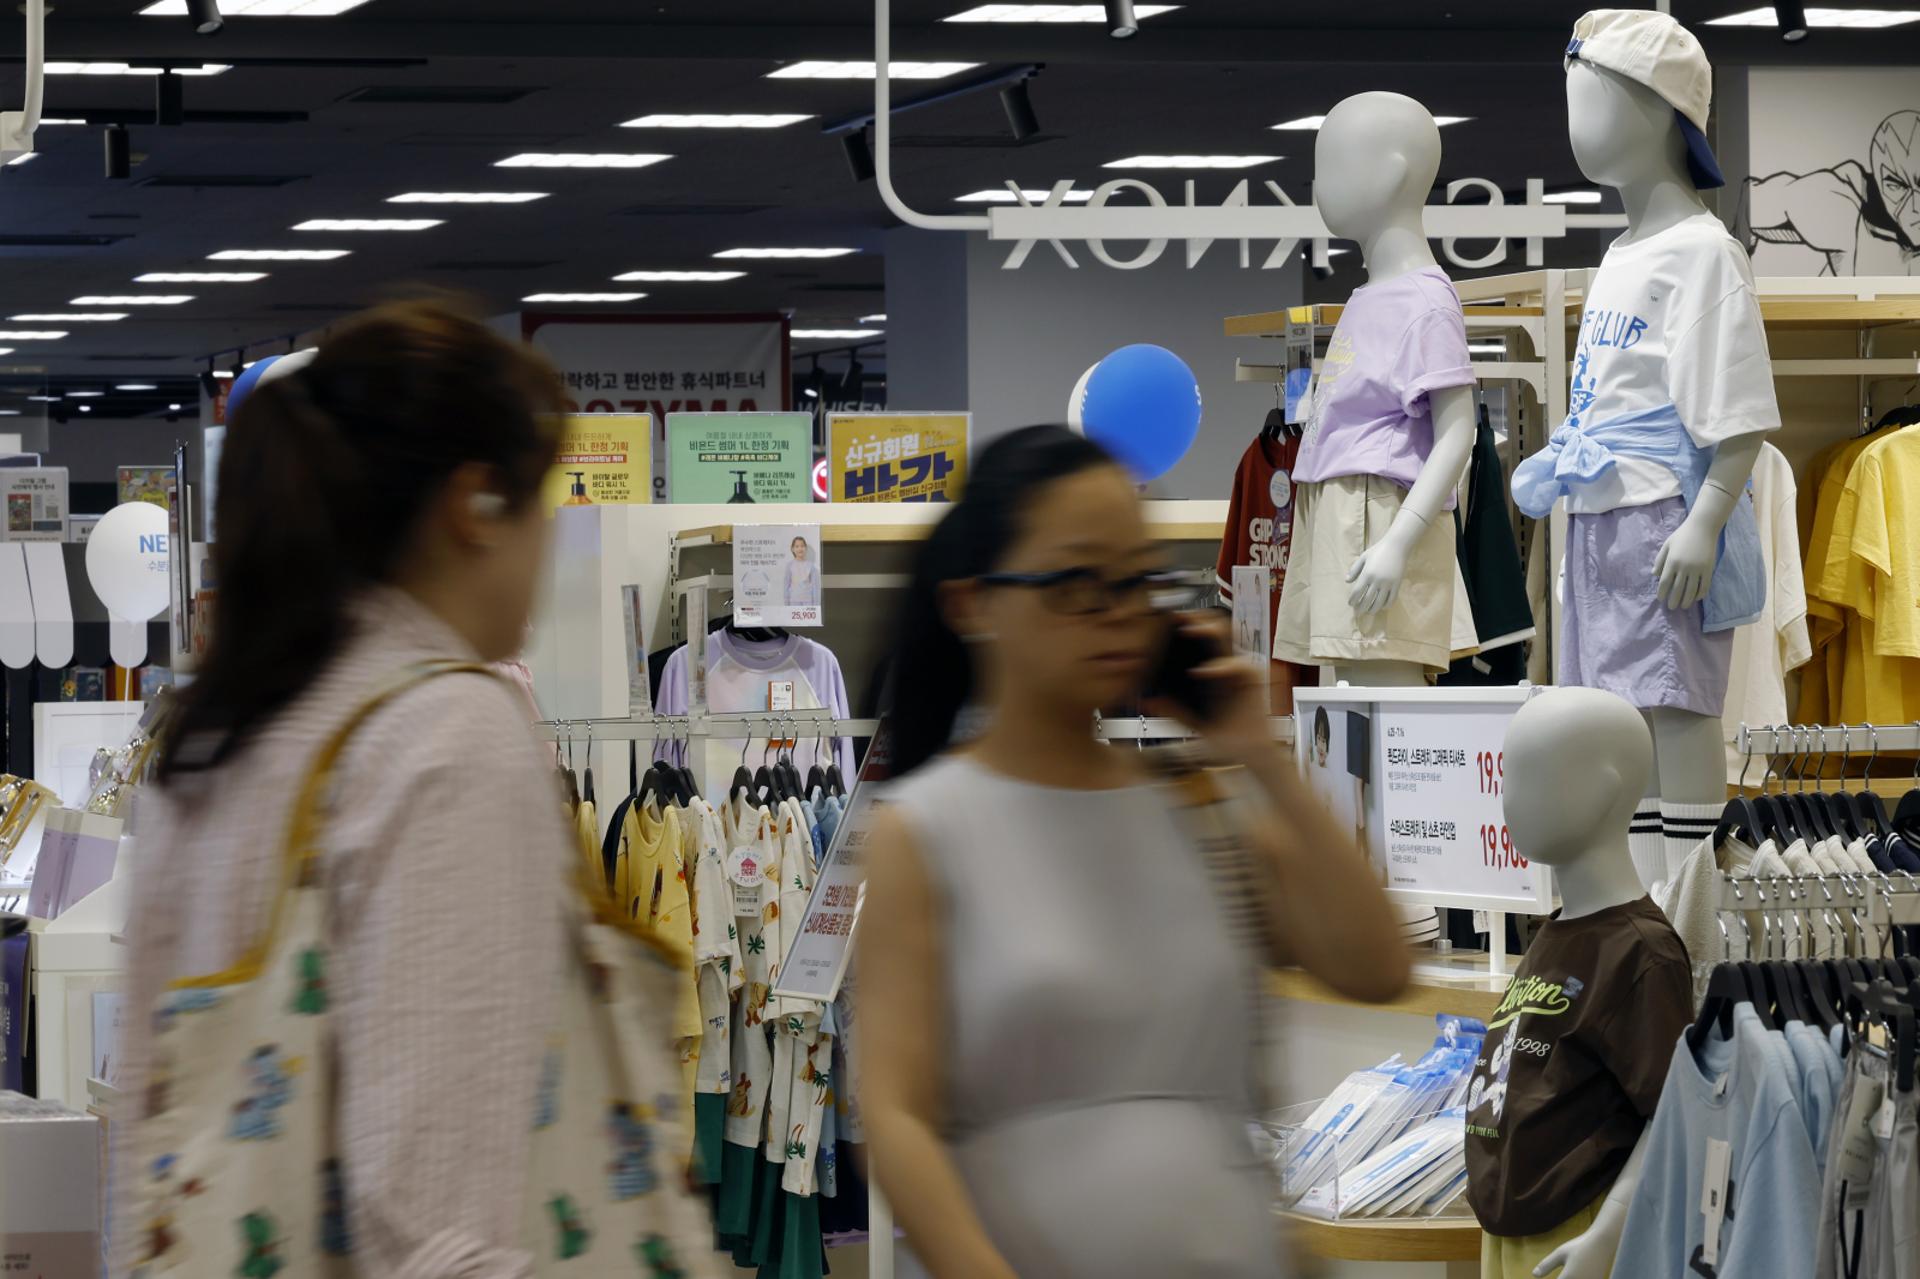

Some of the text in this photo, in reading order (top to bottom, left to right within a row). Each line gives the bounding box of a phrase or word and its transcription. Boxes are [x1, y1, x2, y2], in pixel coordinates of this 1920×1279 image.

[1592, 310, 1648, 349] CLUB
[624, 370, 674, 390] 편안한
[681, 370, 766, 390] 휴식파트너
[577, 442, 588, 452] 1L
[591, 441, 608, 452] 한정
[611, 440, 629, 452] 기획
[739, 441, 749, 450] 1L
[752, 440, 769, 451] 한정
[772, 440, 790, 451] 기획
[845, 432, 920, 468] 신규회원
[147, 560, 169, 572] 수분
[791, 611, 816, 621] 25,900
[1432, 749, 1448, 768] 그래픽
[1449, 749, 1466, 768] 티셔츠
[1476, 751, 1504, 797] 19,9
[1421, 821, 1428, 838] 및
[1439, 821, 1456, 840] 라인업
[1513, 1036, 1551, 1057] 1998
